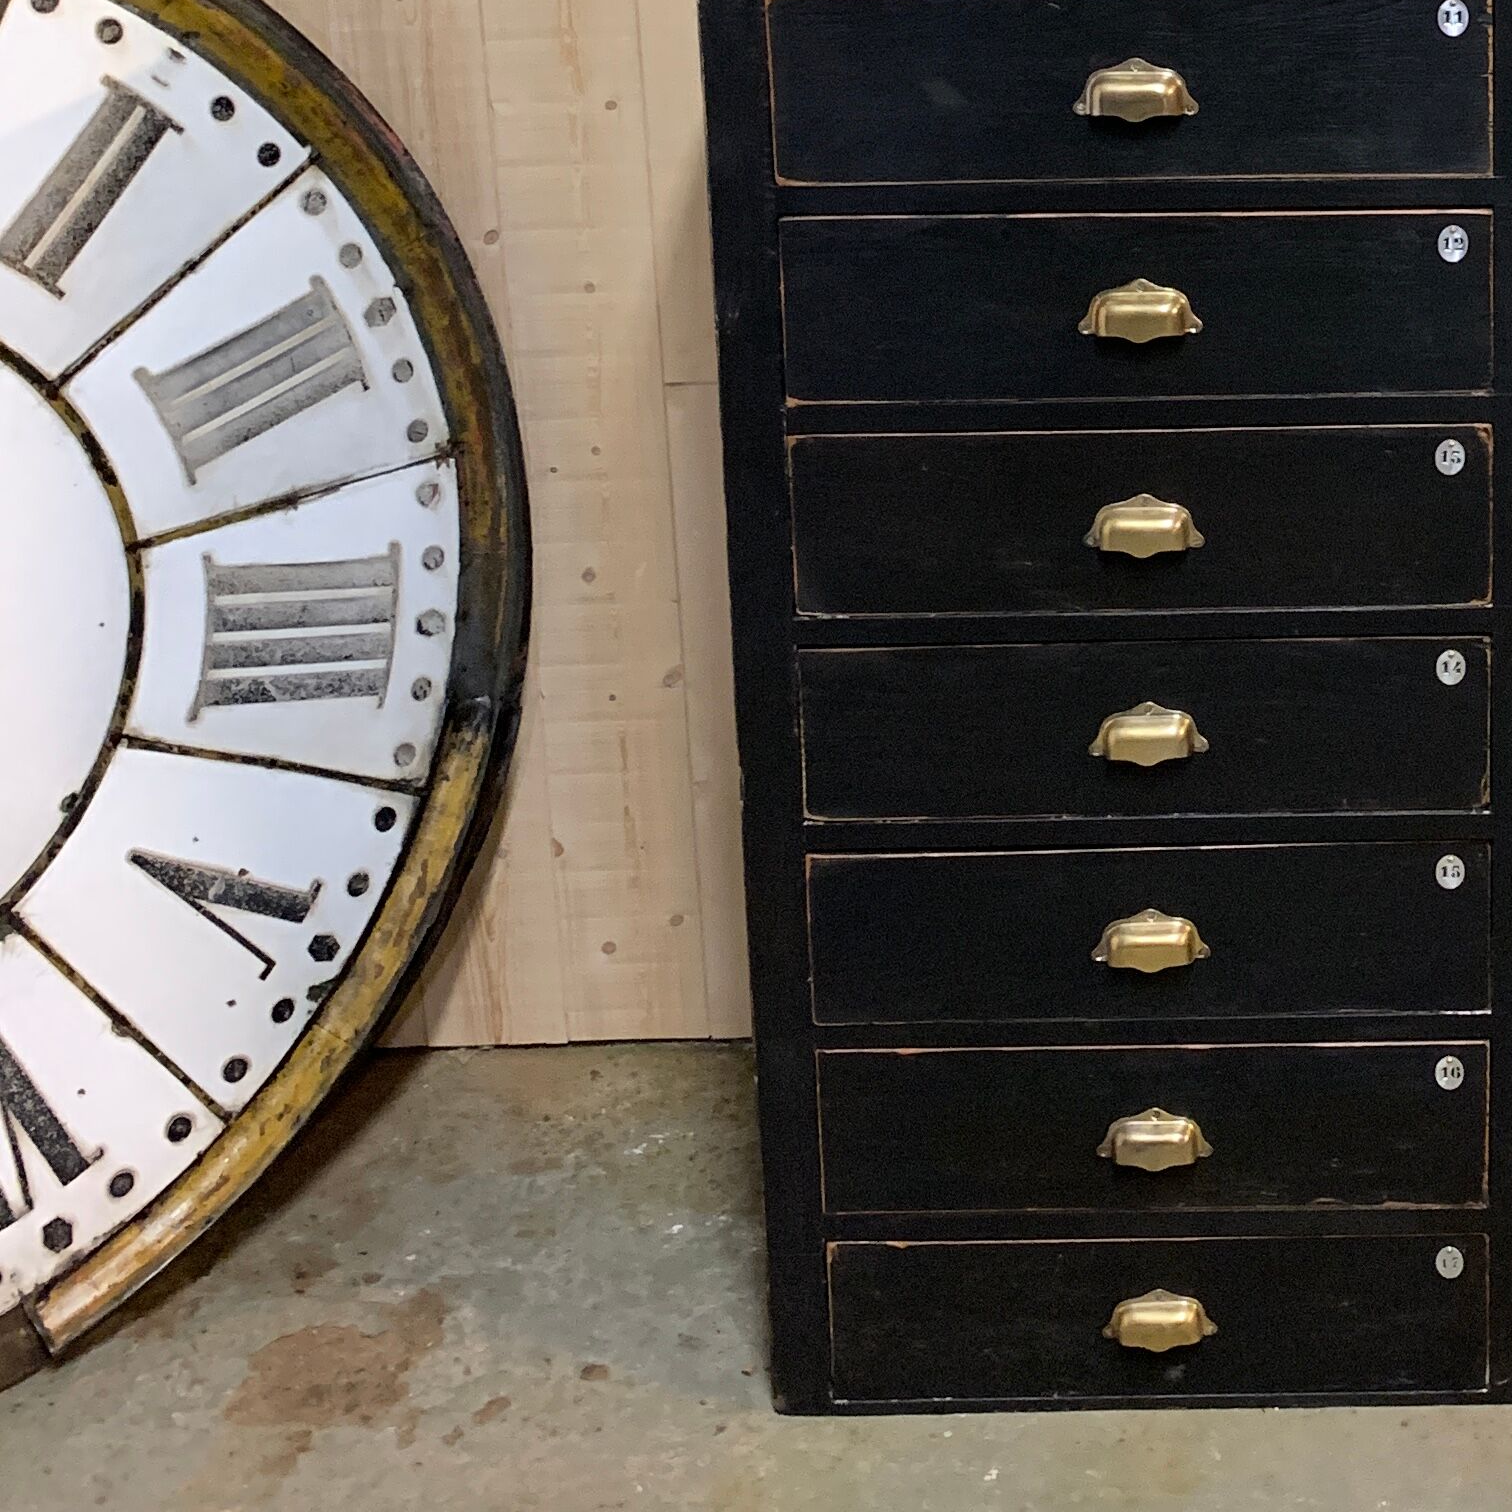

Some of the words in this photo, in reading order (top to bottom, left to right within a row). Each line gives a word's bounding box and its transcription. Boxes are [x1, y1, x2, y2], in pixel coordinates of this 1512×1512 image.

[1443, 10, 1464, 24] 11
[1443, 237, 1464, 251] 12
[1441, 1065, 1461, 1079] 16
